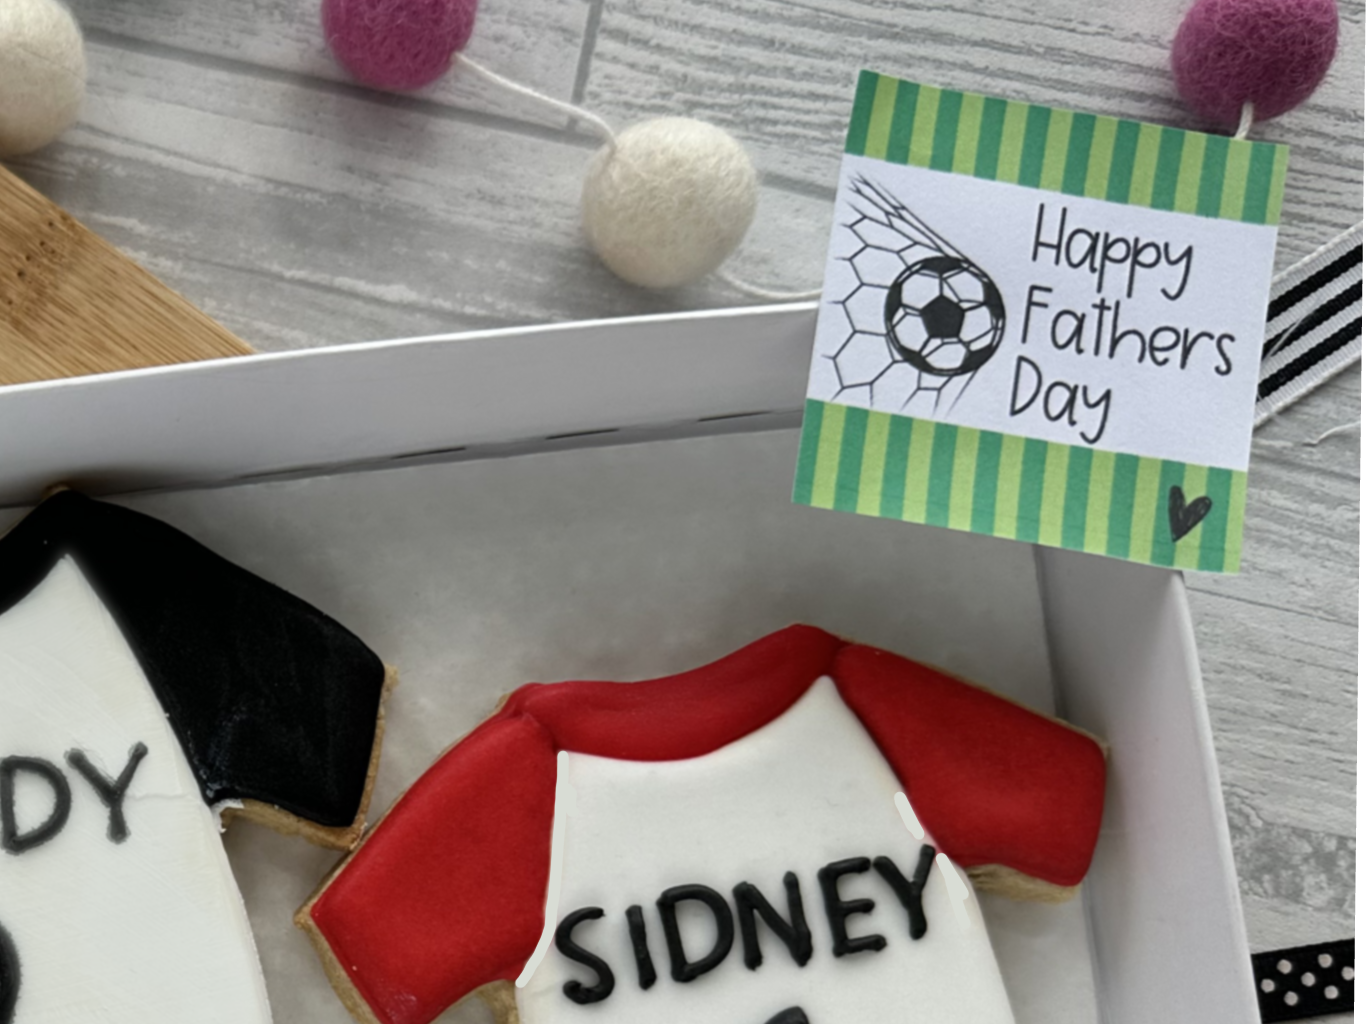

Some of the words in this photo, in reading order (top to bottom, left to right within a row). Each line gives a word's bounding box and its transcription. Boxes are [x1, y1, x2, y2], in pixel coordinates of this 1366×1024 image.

[1032, 203, 1193, 300] Happy
[1021, 285, 1236, 376] Fathers
[1009, 355, 1112, 444] Day
[555, 844, 935, 1004] SIDNEY
